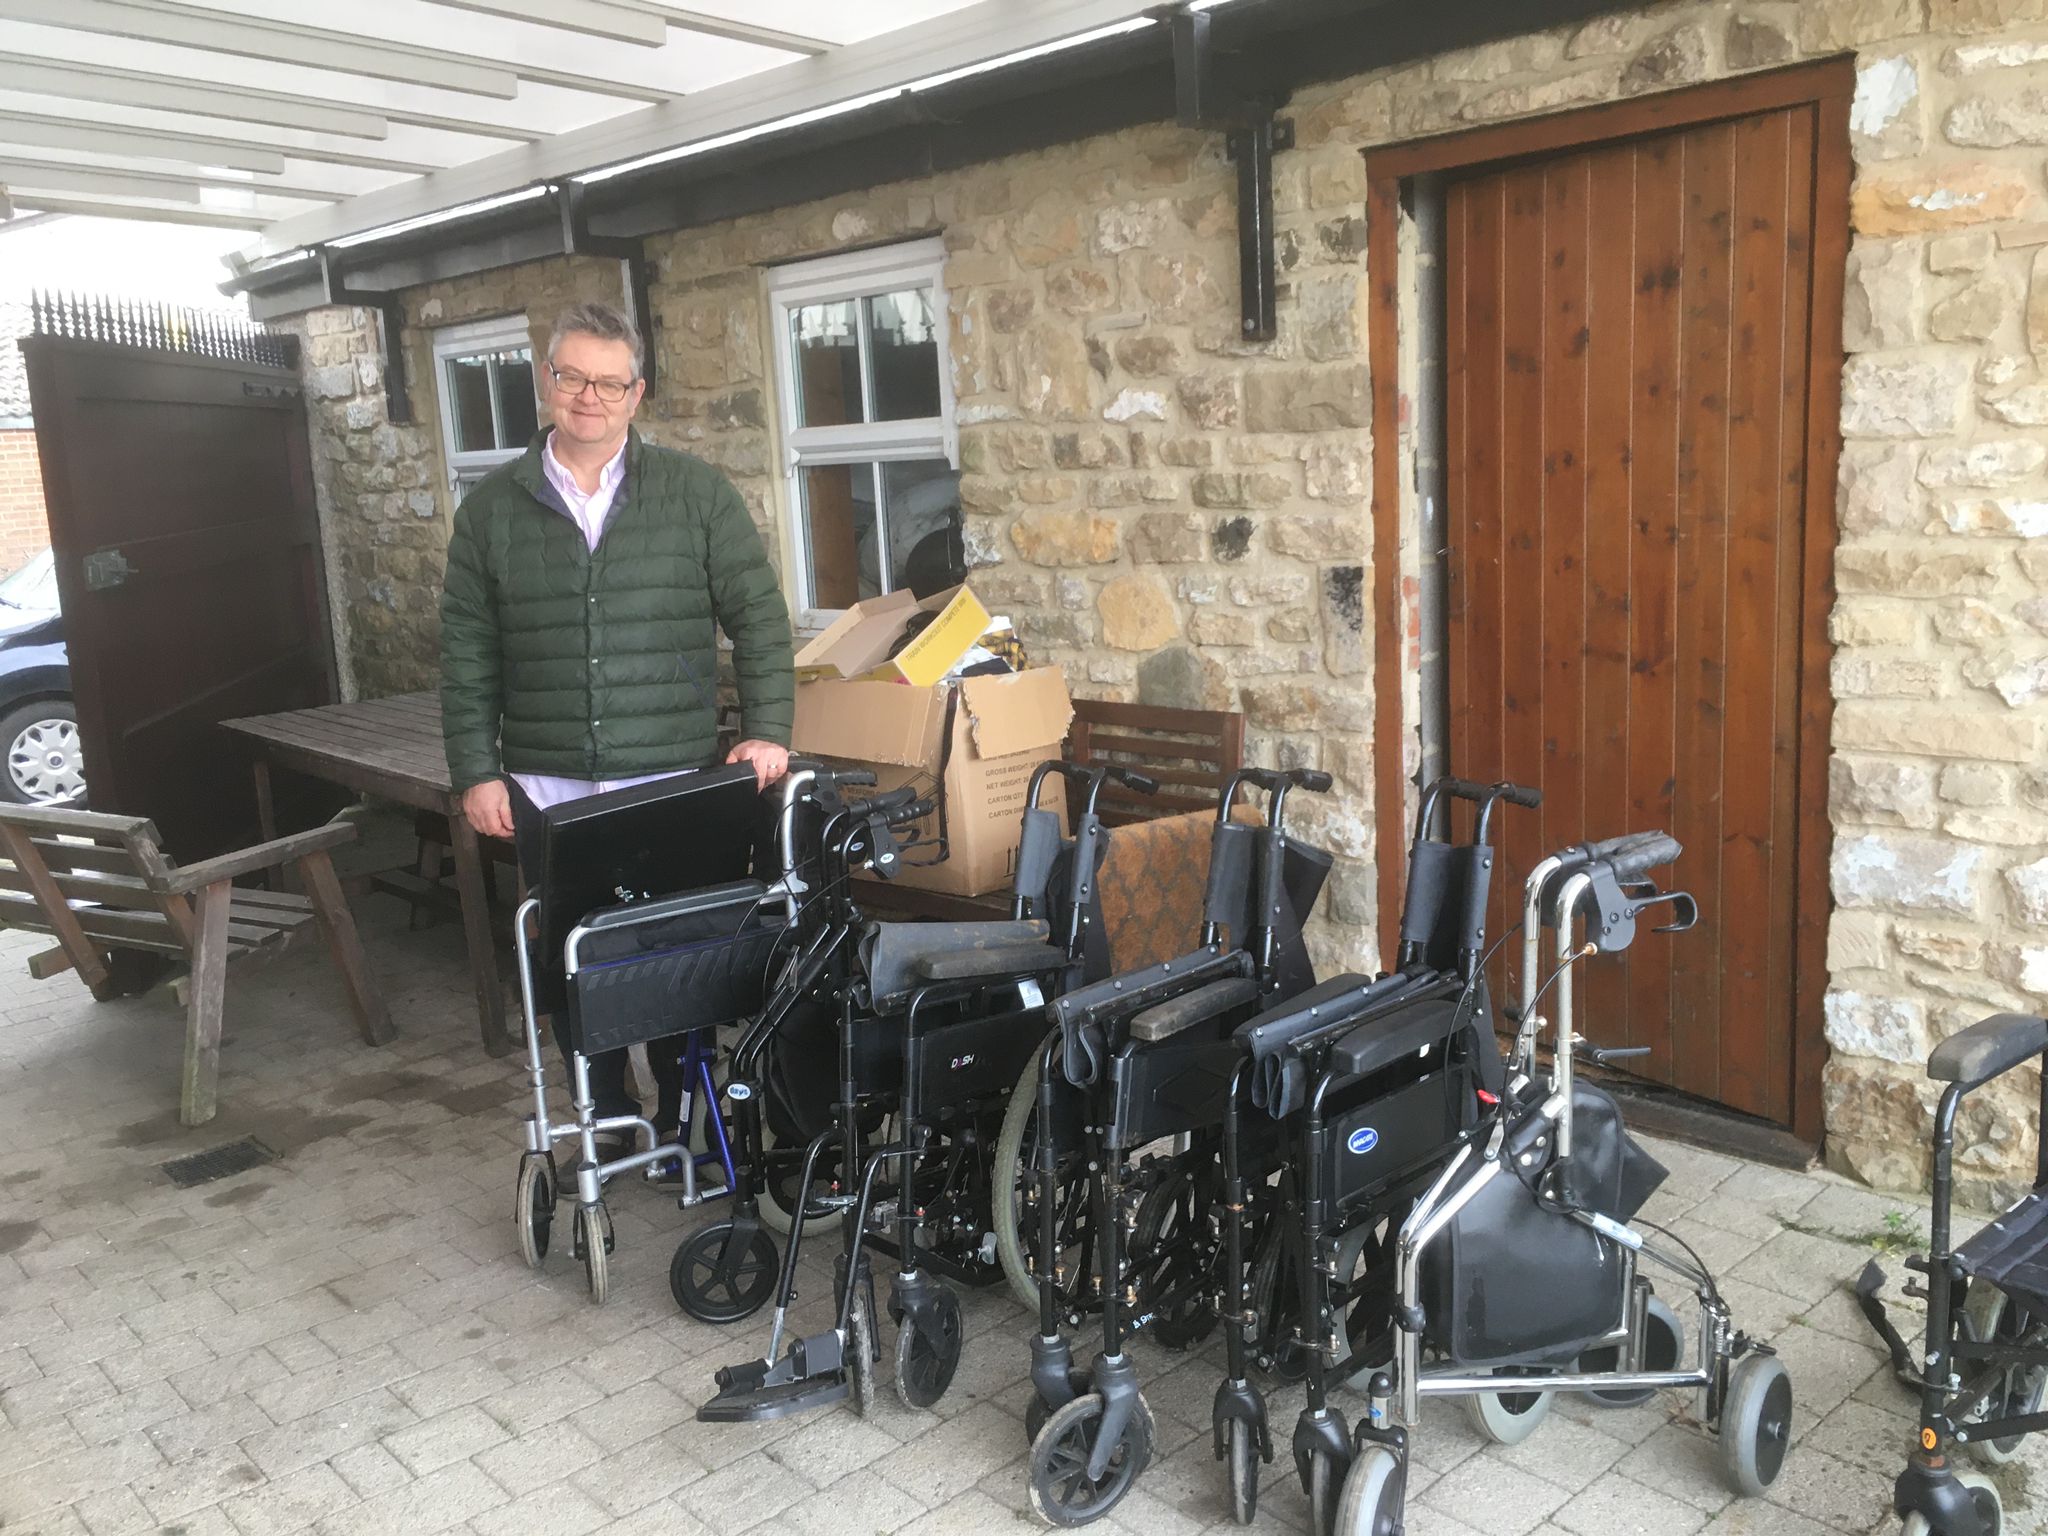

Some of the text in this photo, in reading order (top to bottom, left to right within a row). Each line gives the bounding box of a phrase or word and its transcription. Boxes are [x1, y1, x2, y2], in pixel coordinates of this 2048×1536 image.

[986, 782, 999, 790] NET
[987, 794, 1012, 804] CARTON
[988, 808, 1013, 819] CARTON
